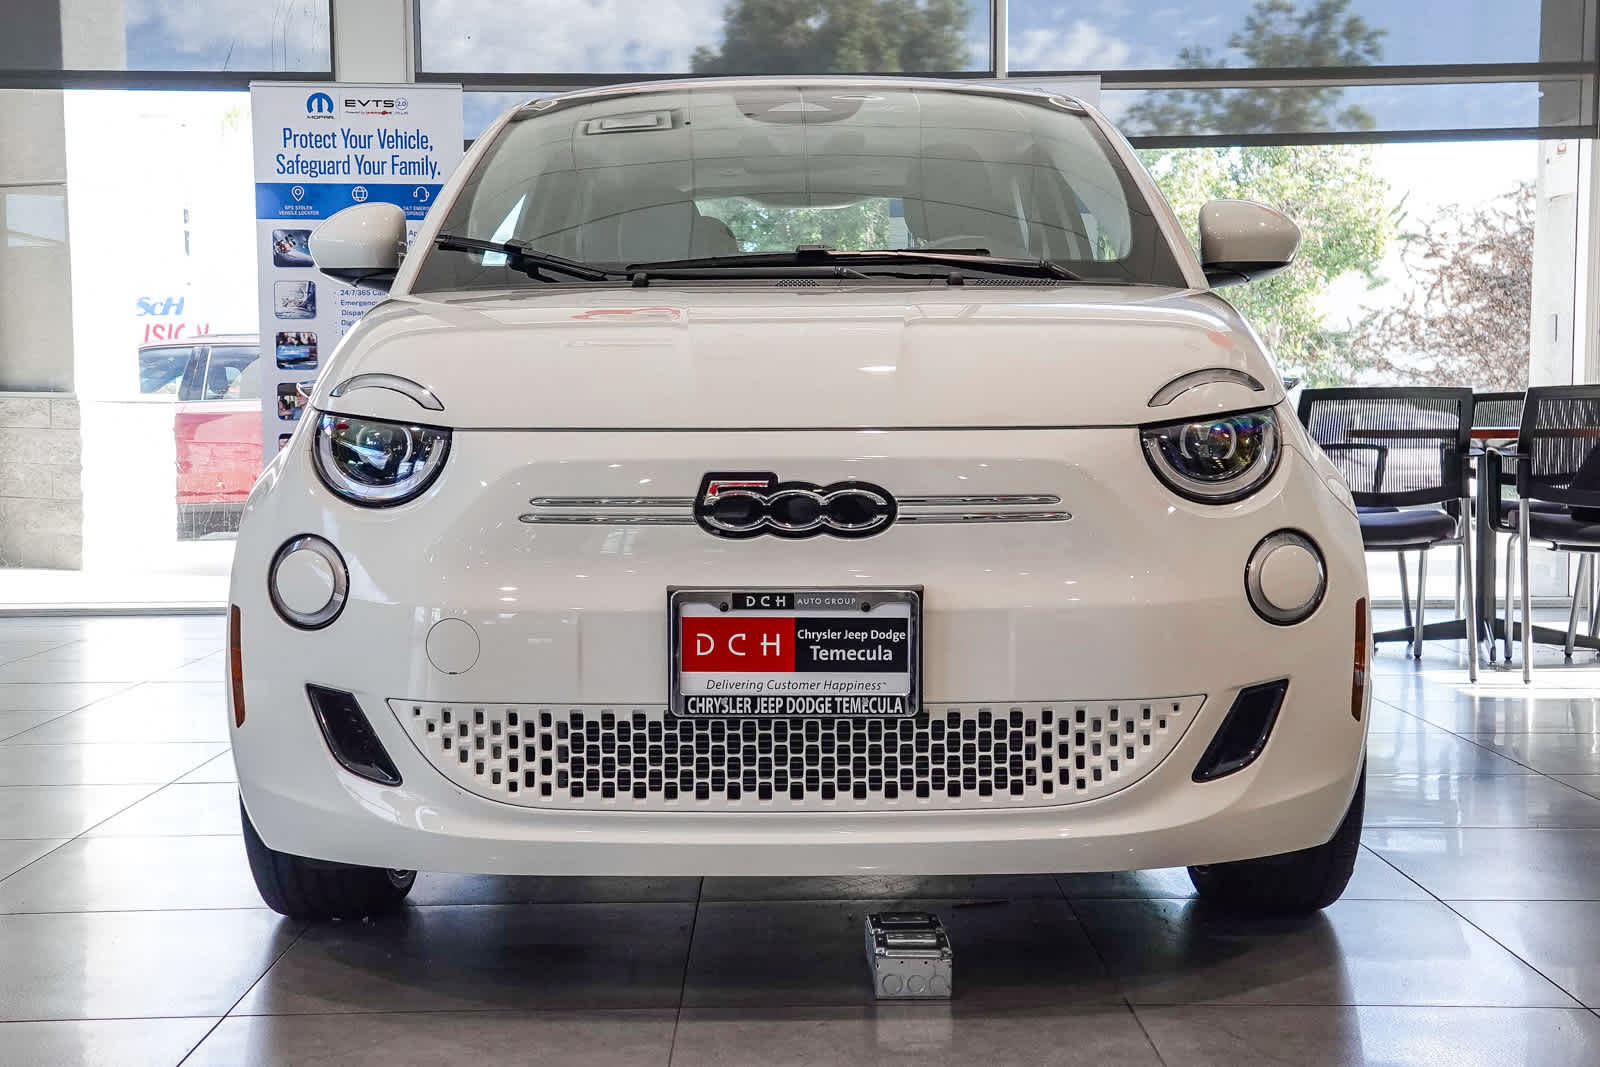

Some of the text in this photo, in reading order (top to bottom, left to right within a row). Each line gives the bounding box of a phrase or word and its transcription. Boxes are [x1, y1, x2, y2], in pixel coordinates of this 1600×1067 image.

[344, 99, 395, 108] EVTS
[282, 127, 433, 151] Protect Your Vehicle,
[276, 153, 441, 179] Safeguard Your Family.
[703, 479, 889, 532] 500
[746, 596, 856, 607] DCH AUTO GROUP
[797, 629, 906, 642] Chrysler Jeep Dodge
[696, 633, 781, 656] DCH
[809, 644, 893, 661] Temecula
[706, 679, 764, 692] Delivering
[765, 679, 821, 691] Customer
[687, 697, 752, 714] CHRYSLER
[754, 697, 784, 714] JEEP
[786, 697, 832, 714] DODGE
